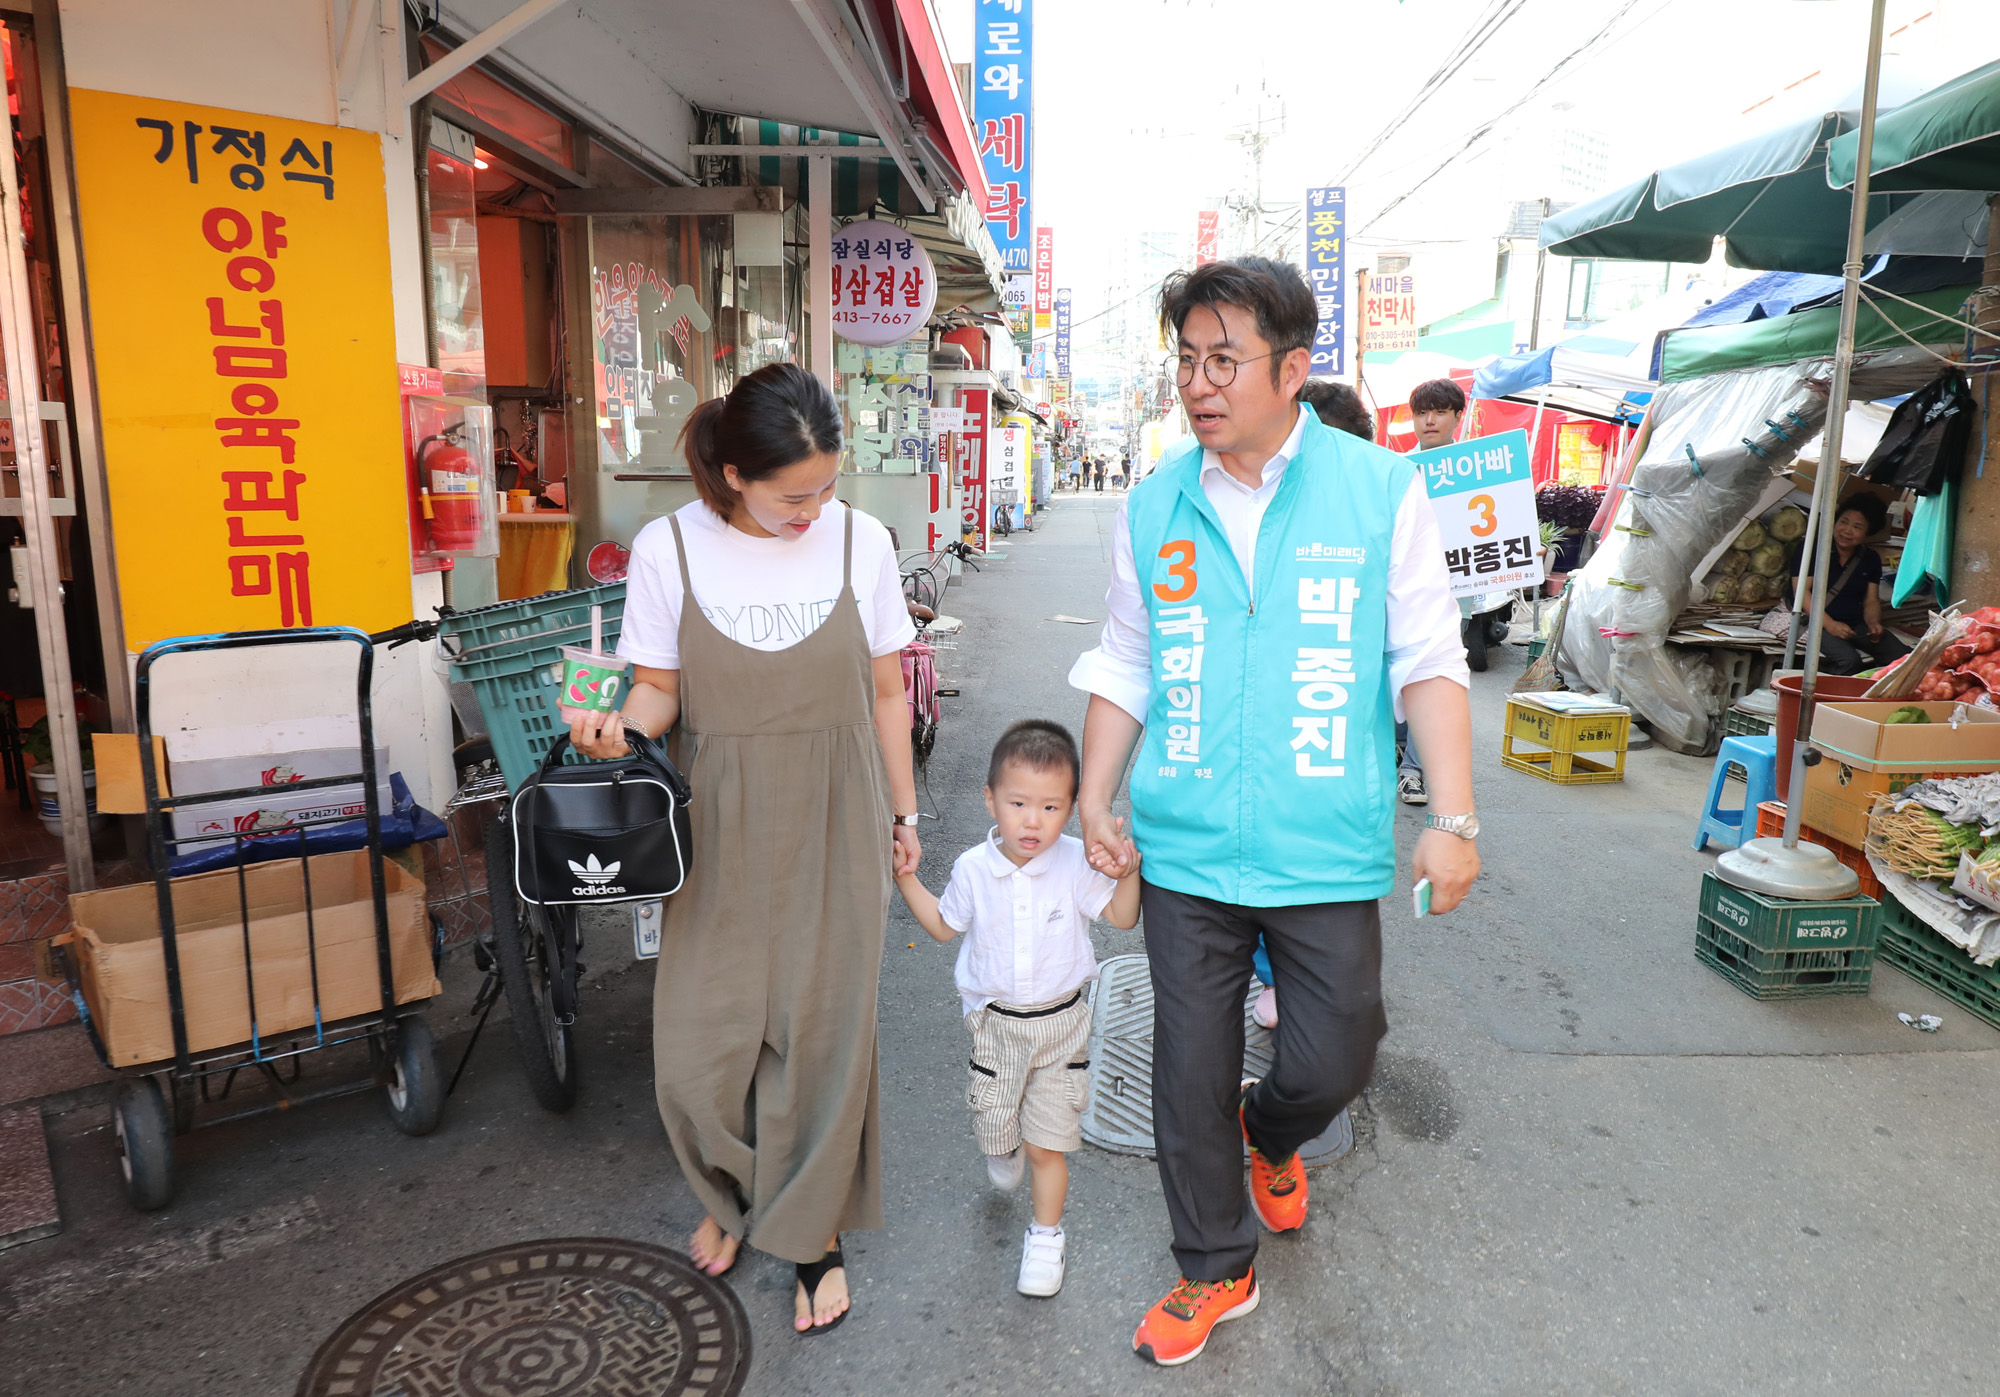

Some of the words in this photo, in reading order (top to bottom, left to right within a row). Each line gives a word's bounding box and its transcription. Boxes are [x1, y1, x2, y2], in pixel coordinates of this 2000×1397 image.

[136, 117, 335, 200] 가정식
[978, 114, 1025, 240] 세탁
[1308, 190, 1344, 206] 셀프
[832, 238, 914, 260] 잠실식당
[1308, 211, 1343, 263] 풍천
[1037, 234, 1051, 310] 조은김밥
[1369, 276, 1414, 294] 새마을
[832, 311, 912, 325] 413-7667
[1310, 267, 1342, 372] 민물장어
[1367, 297, 1416, 326] 천막사
[1365, 330, 1417, 341] 010-5305-6141
[403, 369, 429, 390] 소화기
[201, 206, 313, 628] 양념육판매
[1421, 444, 1514, 490] 넷아빠
[1468, 494, 1498, 537] 3
[1152, 539, 1198, 602] 3
[1295, 542, 1366, 565] 바른미래당
[1445, 536, 1533, 577] 박종진
[1490, 572, 1522, 584] 국회의원
[700, 599, 861, 642] YDNE
[1155, 604, 1209, 763] 국회의원
[1289, 576, 1361, 777] 박종진
[298, 807, 341, 820] 돼지고기
[572, 885, 626, 895] adidas
[1797, 926, 1832, 938] 빙그레
